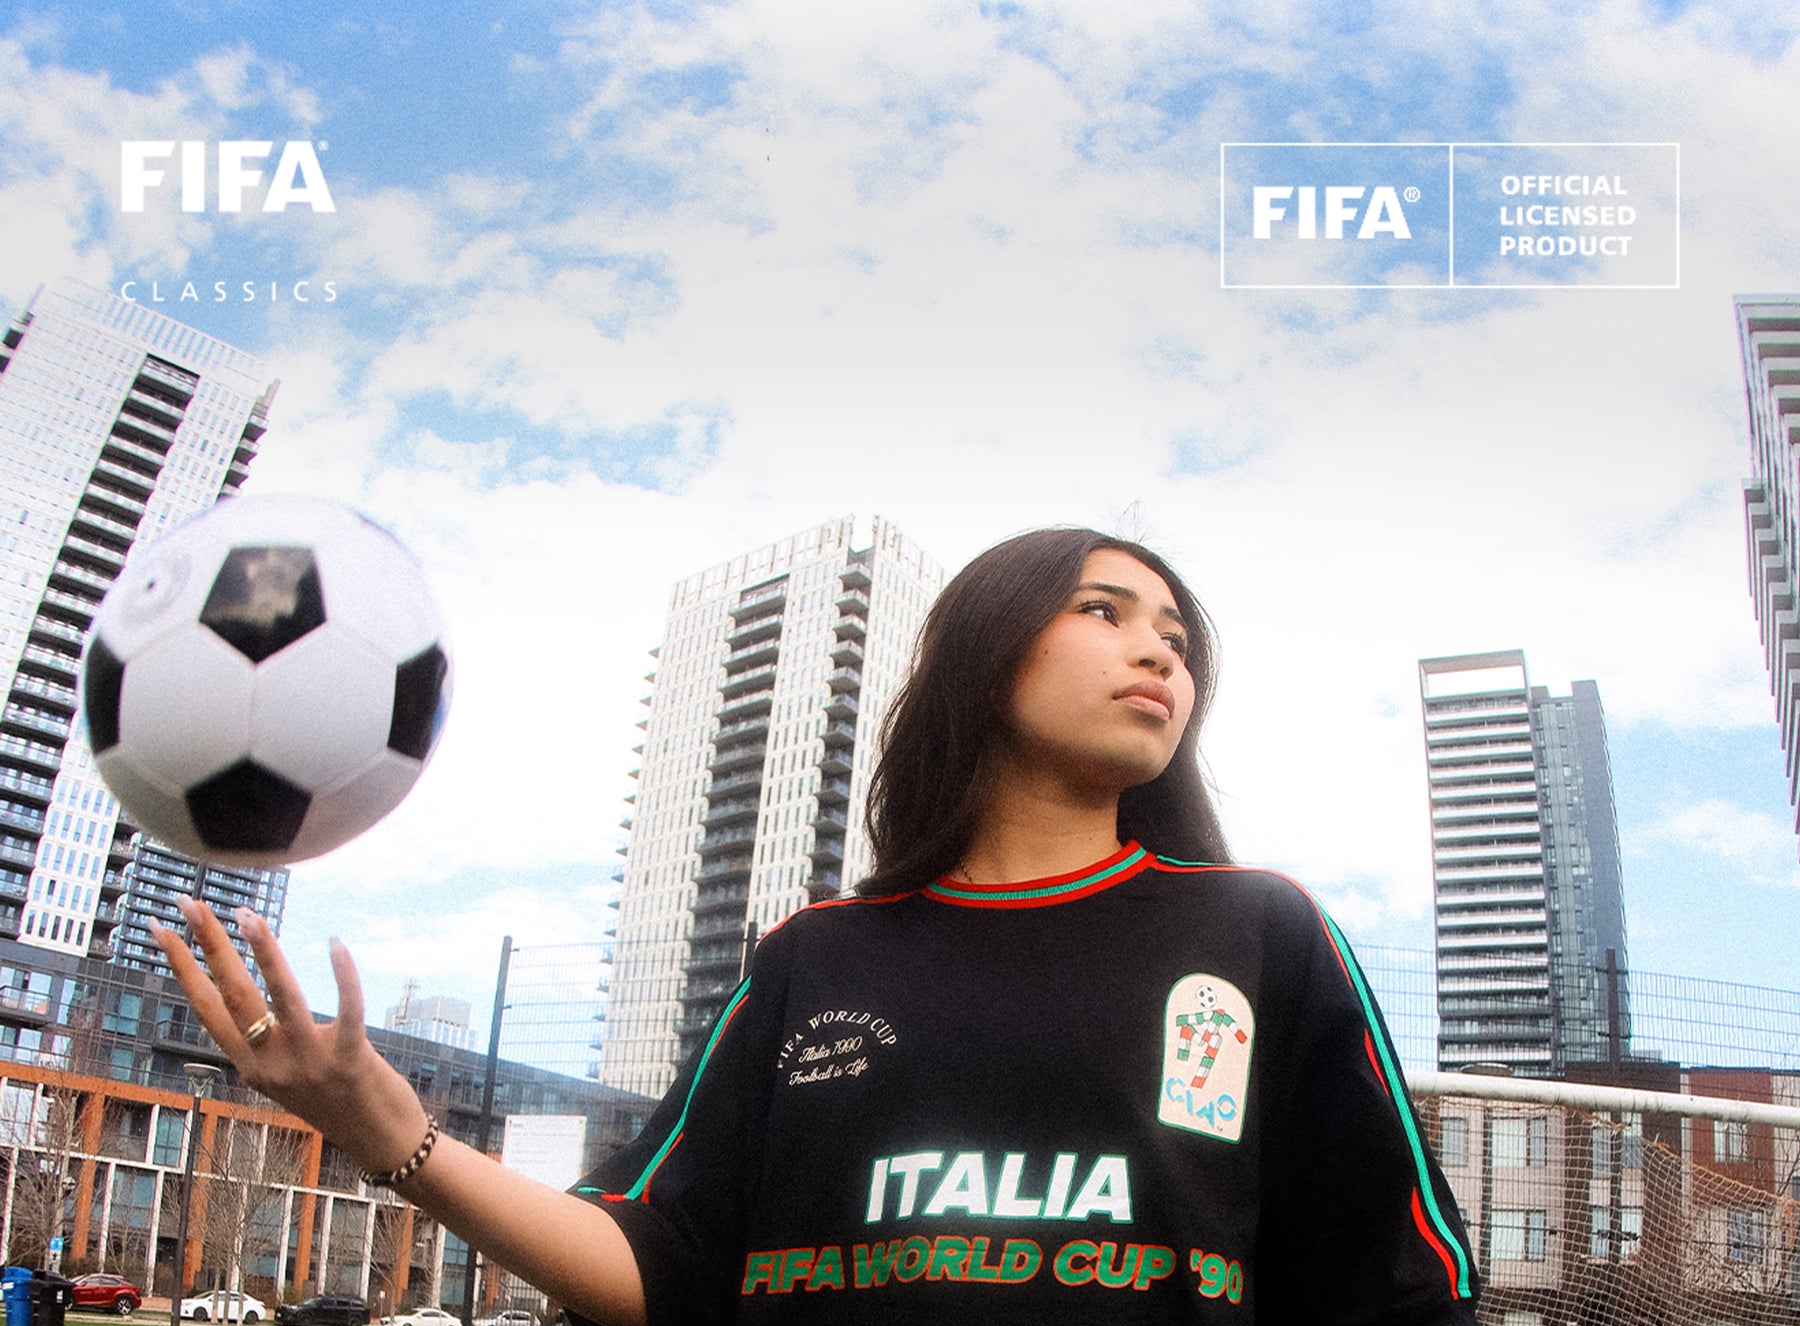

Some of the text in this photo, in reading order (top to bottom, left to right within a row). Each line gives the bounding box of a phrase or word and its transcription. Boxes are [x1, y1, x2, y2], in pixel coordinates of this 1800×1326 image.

[808, 1010, 871, 1030] WORLD
[870, 1018, 897, 1046] CUP
[831, 1035, 863, 1056] 1990
[788, 1056, 869, 1086] Football is Life
[1166, 1077, 1237, 1127] CIAO
[865, 1151, 1134, 1223] ITALIA
[741, 1235, 1244, 1305] FIFA WORLD CUP '90
